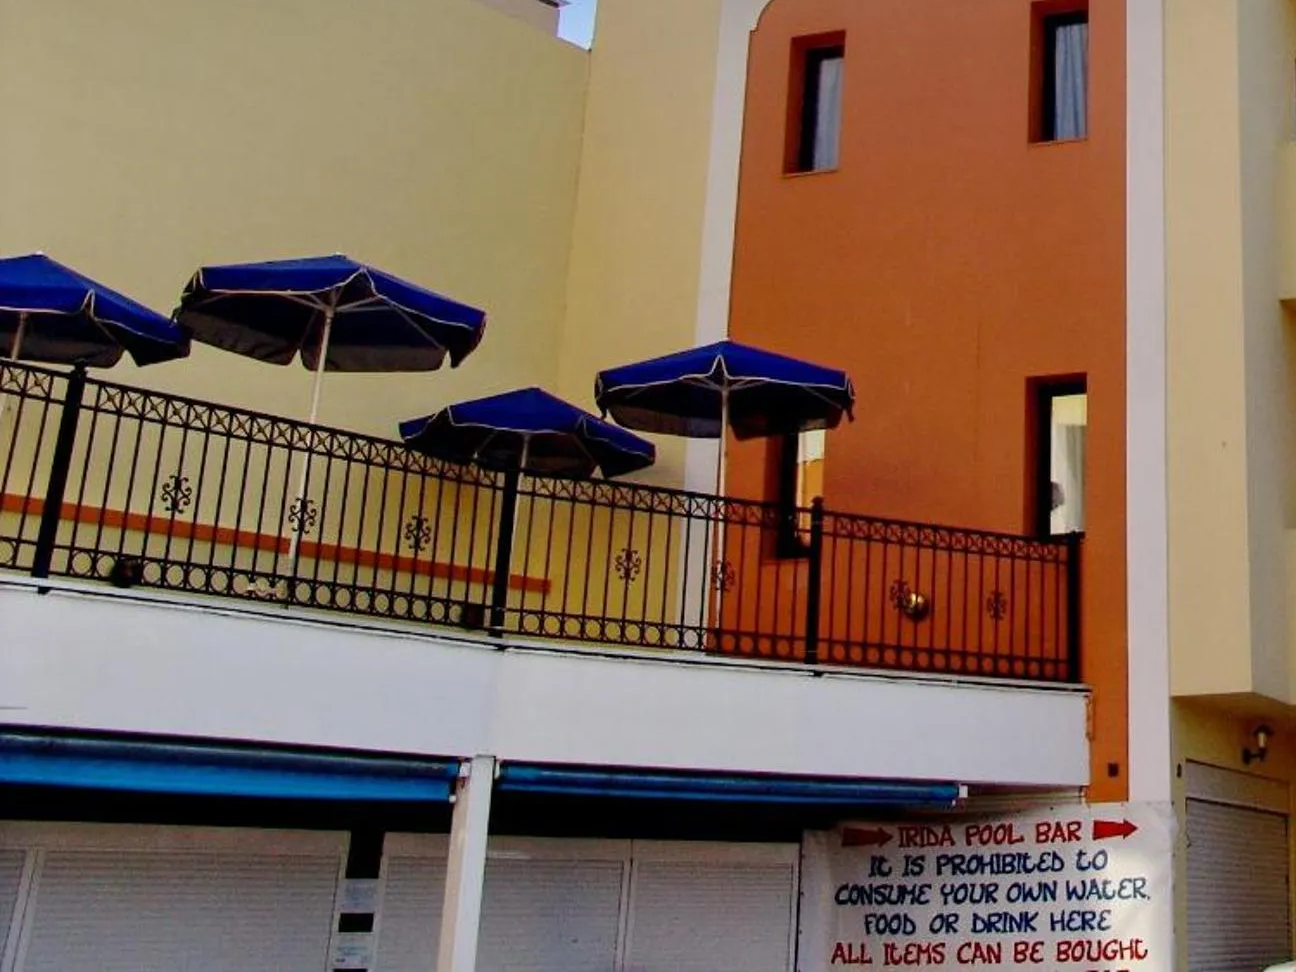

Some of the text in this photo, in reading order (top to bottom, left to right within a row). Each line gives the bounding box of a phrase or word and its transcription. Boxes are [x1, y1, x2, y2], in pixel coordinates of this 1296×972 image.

[898, 821, 1082, 848] IRIDA POOL BAR
[902, 855, 925, 876] IS
[834, 882, 932, 906] CONSUME
[940, 881, 999, 905] YOUR
[1006, 879, 1058, 903] OWN
[864, 909, 1111, 935] FOOD OR DRINK HERE
[831, 942, 873, 964] ALL
[957, 940, 1002, 964] CAN
[1014, 940, 1045, 963] BE
